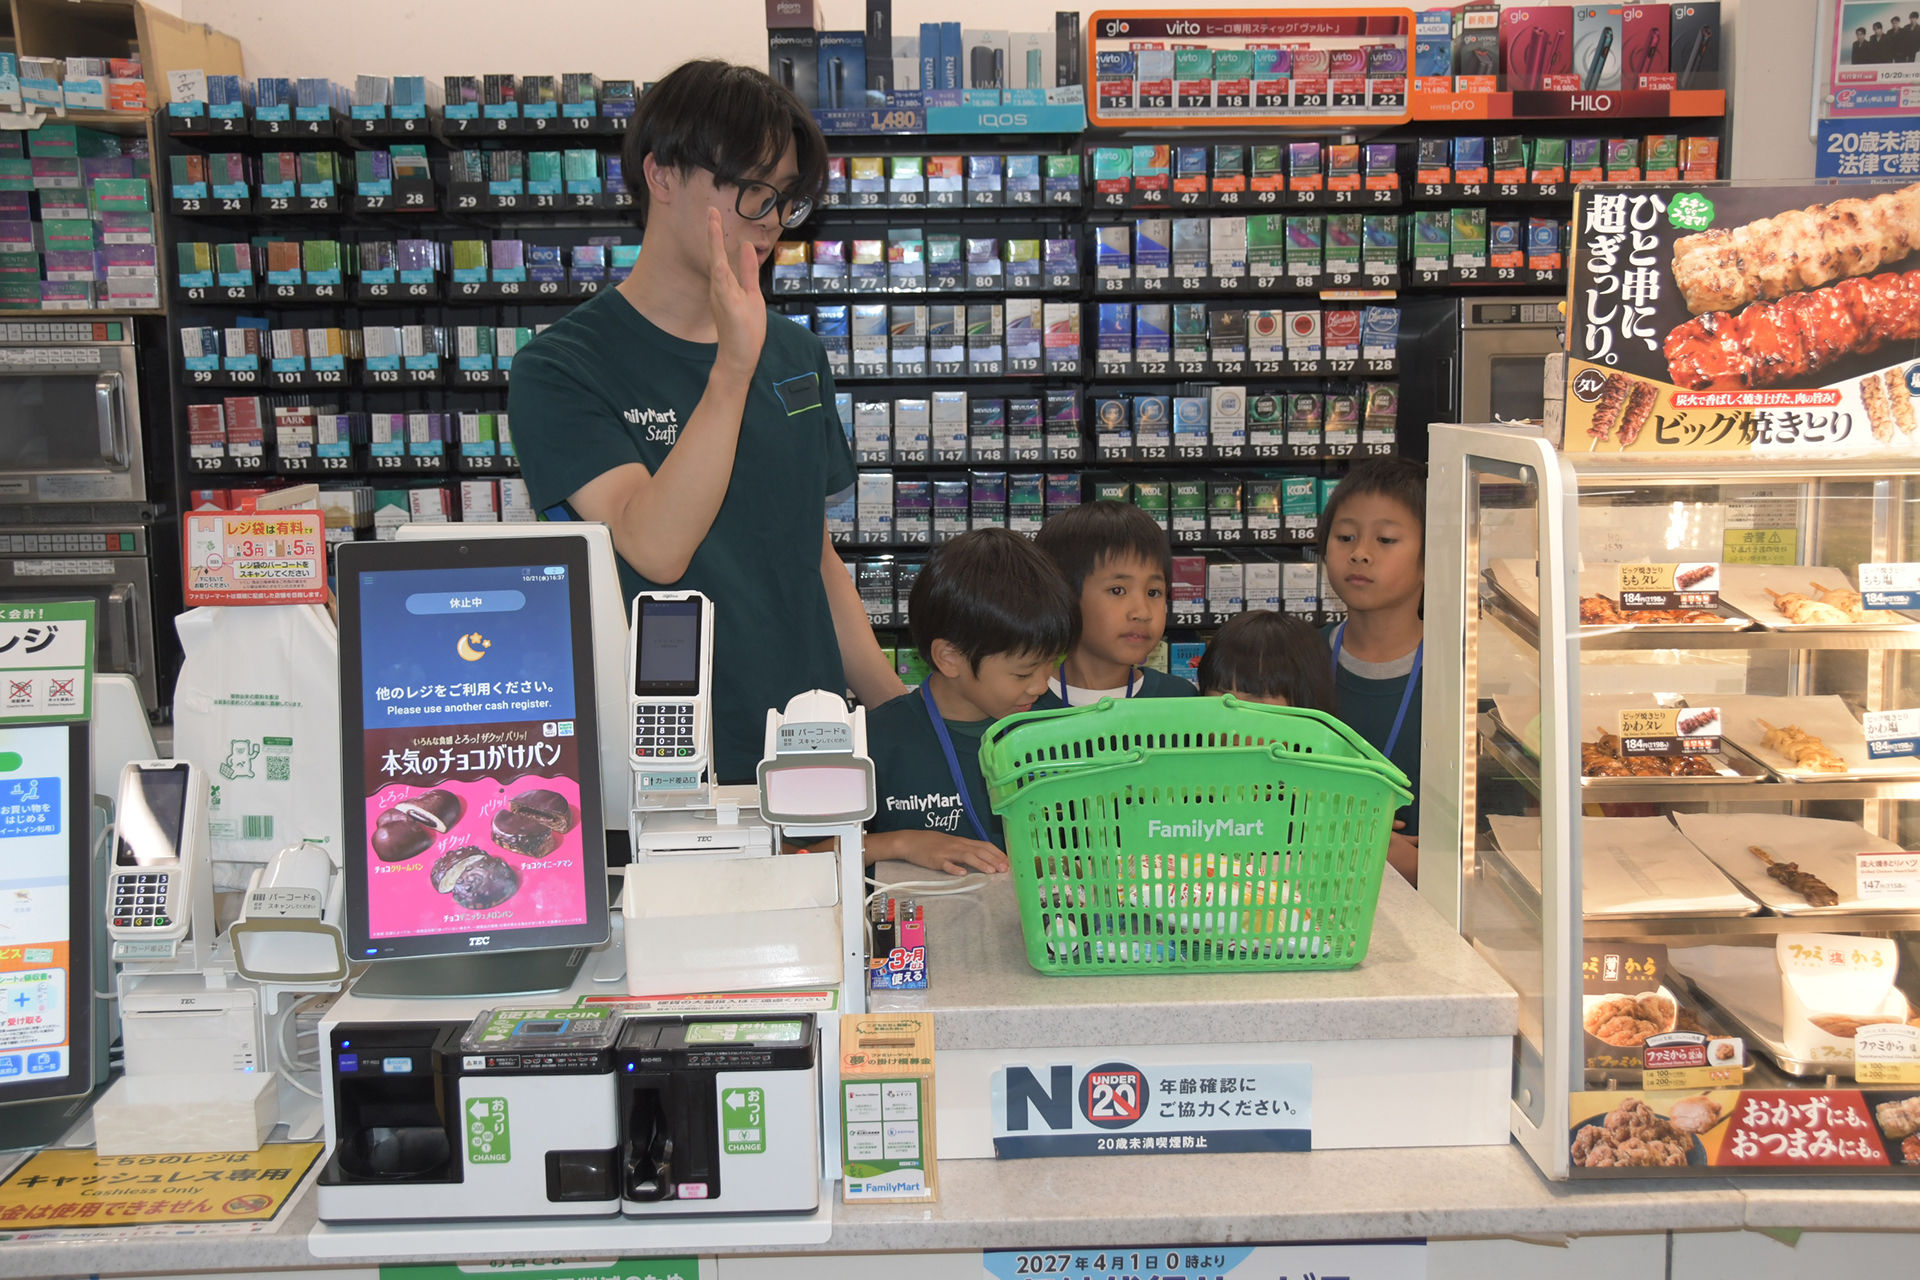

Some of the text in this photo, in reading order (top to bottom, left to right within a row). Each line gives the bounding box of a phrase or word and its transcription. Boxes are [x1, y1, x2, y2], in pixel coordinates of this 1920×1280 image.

[1510, 10, 1529, 24] glo
[1577, 8, 1597, 21] glo
[1624, 8, 1644, 22] glo
[1675, 5, 1695, 20] glo
[1468, 15, 1495, 25] 新発売
[1106, 22, 1130, 37] glo
[1166, 21, 1201, 36] virto
[1100, 53, 1120, 64] virto
[1177, 52, 1198, 63] virto
[1217, 52, 1238, 63] virto
[1256, 52, 1278, 63] virto
[1295, 52, 1316, 62] virto
[1332, 52, 1353, 62] virto
[1111, 97, 1126, 107] 15
[1226, 96, 1242, 106] 18
[1379, 95, 1397, 106] 22
[1571, 94, 1611, 111] HILO
[1451, 99, 1475, 114] pro
[185, 118, 191, 128] 1
[498, 120, 506, 130] 8
[978, 113, 1028, 126] IQOS
[366, 121, 374, 131] 5
[1827, 131, 1920, 153] 20歳未満
[1838, 153, 1920, 175] 法律で禁
[1502, 185, 1517, 195] 55
[577, 195, 593, 205] 32
[938, 193, 952, 203] 41
[1054, 192, 1071, 201] 44
[1221, 193, 1238, 203] 48
[1375, 191, 1390, 201] 52
[271, 199, 288, 209] 25
[460, 197, 476, 207] 29
[1679, 197, 1709, 213] チキン
[532, 251, 554, 260] evo
[1423, 272, 1438, 281] 91
[1621, 194, 1666, 351] ひと串に、
[861, 278, 877, 288] 77
[1015, 276, 1030, 286] 81
[1145, 279, 1161, 289] 84
[1296, 277, 1313, 286] 88
[1584, 194, 1628, 365] 超ぎっしり。
[278, 286, 294, 296] 63
[410, 285, 427, 294] 66
[580, 282, 597, 292] 70
[858, 363, 883, 374] 115
[1013, 360, 1037, 369] 119
[1142, 363, 1165, 373] 122
[1293, 362, 1317, 371] 126
[194, 372, 211, 381] 99
[316, 371, 340, 381] 102
[1577, 378, 1604, 393] タレ
[1047, 396, 1068, 404] MEVIUS
[1675, 392, 1836, 407] 炭火で香ばしく焼き上げた、肉の旨み!
[973, 406, 993, 414] MEVIUS
[281, 416, 305, 425] LARK
[1654, 410, 1853, 446] ビッグ焼きとり
[646, 424, 678, 445] Staff
[1010, 449, 1038, 459] 149
[1142, 448, 1165, 457] 152
[1293, 446, 1316, 455] 156
[377, 457, 401, 467] 133
[861, 452, 886, 462] 145
[197, 459, 221, 468] 129
[503, 483, 513, 506] LARK
[1102, 487, 1123, 497] KOOL
[1141, 486, 1162, 496] KOOL
[1177, 485, 1199, 496] KOOL
[1214, 486, 1235, 496] KOOL
[1253, 485, 1275, 495] KOOL
[463, 485, 473, 510] LARK
[227, 520, 314, 536] レジ袋は有料です
[1291, 529, 1314, 538] 186
[902, 532, 928, 541] 176
[243, 540, 264, 557] 3円
[293, 539, 315, 556] 5円
[239, 560, 309, 570] レジ袋のバーコードを
[1621, 566, 1664, 575] ビッグ焼きとり
[239, 569, 310, 579] スキャンしてください
[1622, 575, 1659, 586] ももタレ
[449, 597, 482, 609] 休止中
[375, 680, 554, 702] 他のレジをご利用ください。
[387, 700, 553, 716] Please use another cash register.
[1622, 712, 1666, 721] ビッグ焼きとり
[1622, 720, 1664, 732] かわタレ
[798, 727, 848, 737] バーコードを
[413, 735, 453, 747] いろんな食感
[798, 737, 848, 745] スキャンしてください
[380, 742, 562, 778] 本気のチョコがけパン
[655, 776, 697, 785] カード差込口
[378, 787, 410, 809] とろっ!
[886, 793, 963, 812] FamilyMart
[0, 803, 52, 816] お買い物を
[478, 795, 507, 818] パリッ!
[5, 813, 47, 824] はじめる
[925, 809, 964, 831] Staff
[1147, 818, 1264, 842] FamilyMart
[436, 834, 471, 854] ザクッ!
[374, 863, 424, 875] チョコクリームパン
[521, 859, 574, 871] チョコクイニーアマン
[268, 892, 317, 902] バーコードを
[443, 910, 514, 923] チョコデニッシュメロンパン
[469, 936, 490, 946] TEC
[130, 944, 172, 954] カード差込口
[1788, 943, 1884, 968] ファミ 塩 から
[1624, 956, 1656, 976] から
[891, 970, 923, 985] 使える
[498, 1010, 601, 1020] 硬貨 COIN
[1859, 1040, 1905, 1051] ファミから
[1646, 1049, 1687, 1062] ファミから
[1092, 1074, 1137, 1085] UNDER
[1159, 1077, 1257, 1095] 年齢確認に
[1092, 1084, 1137, 1117] 20
[747, 1090, 761, 1126] おつり
[1159, 1099, 1297, 1118] ご協力ください。
[1741, 1095, 1868, 1128] おかずにも、
[492, 1100, 505, 1135] おつり
[472, 1124, 484, 1132] 500
[727, 1143, 762, 1151] CHANGE
[1097, 1136, 1208, 1150] 20歳未満喫煙防止
[1731, 1128, 1881, 1160] おつまみにも。
[93, 1153, 251, 1167] こちらのレジは
[472, 1153, 507, 1162] CHANGE
[17, 1168, 293, 1188] キャッシュレス専用
[80, 1185, 205, 1197] Cashless Only
[865, 1182, 920, 1193] FamilyMart
[1016, 1252, 1227, 1274] 2027年4月1日0時より
